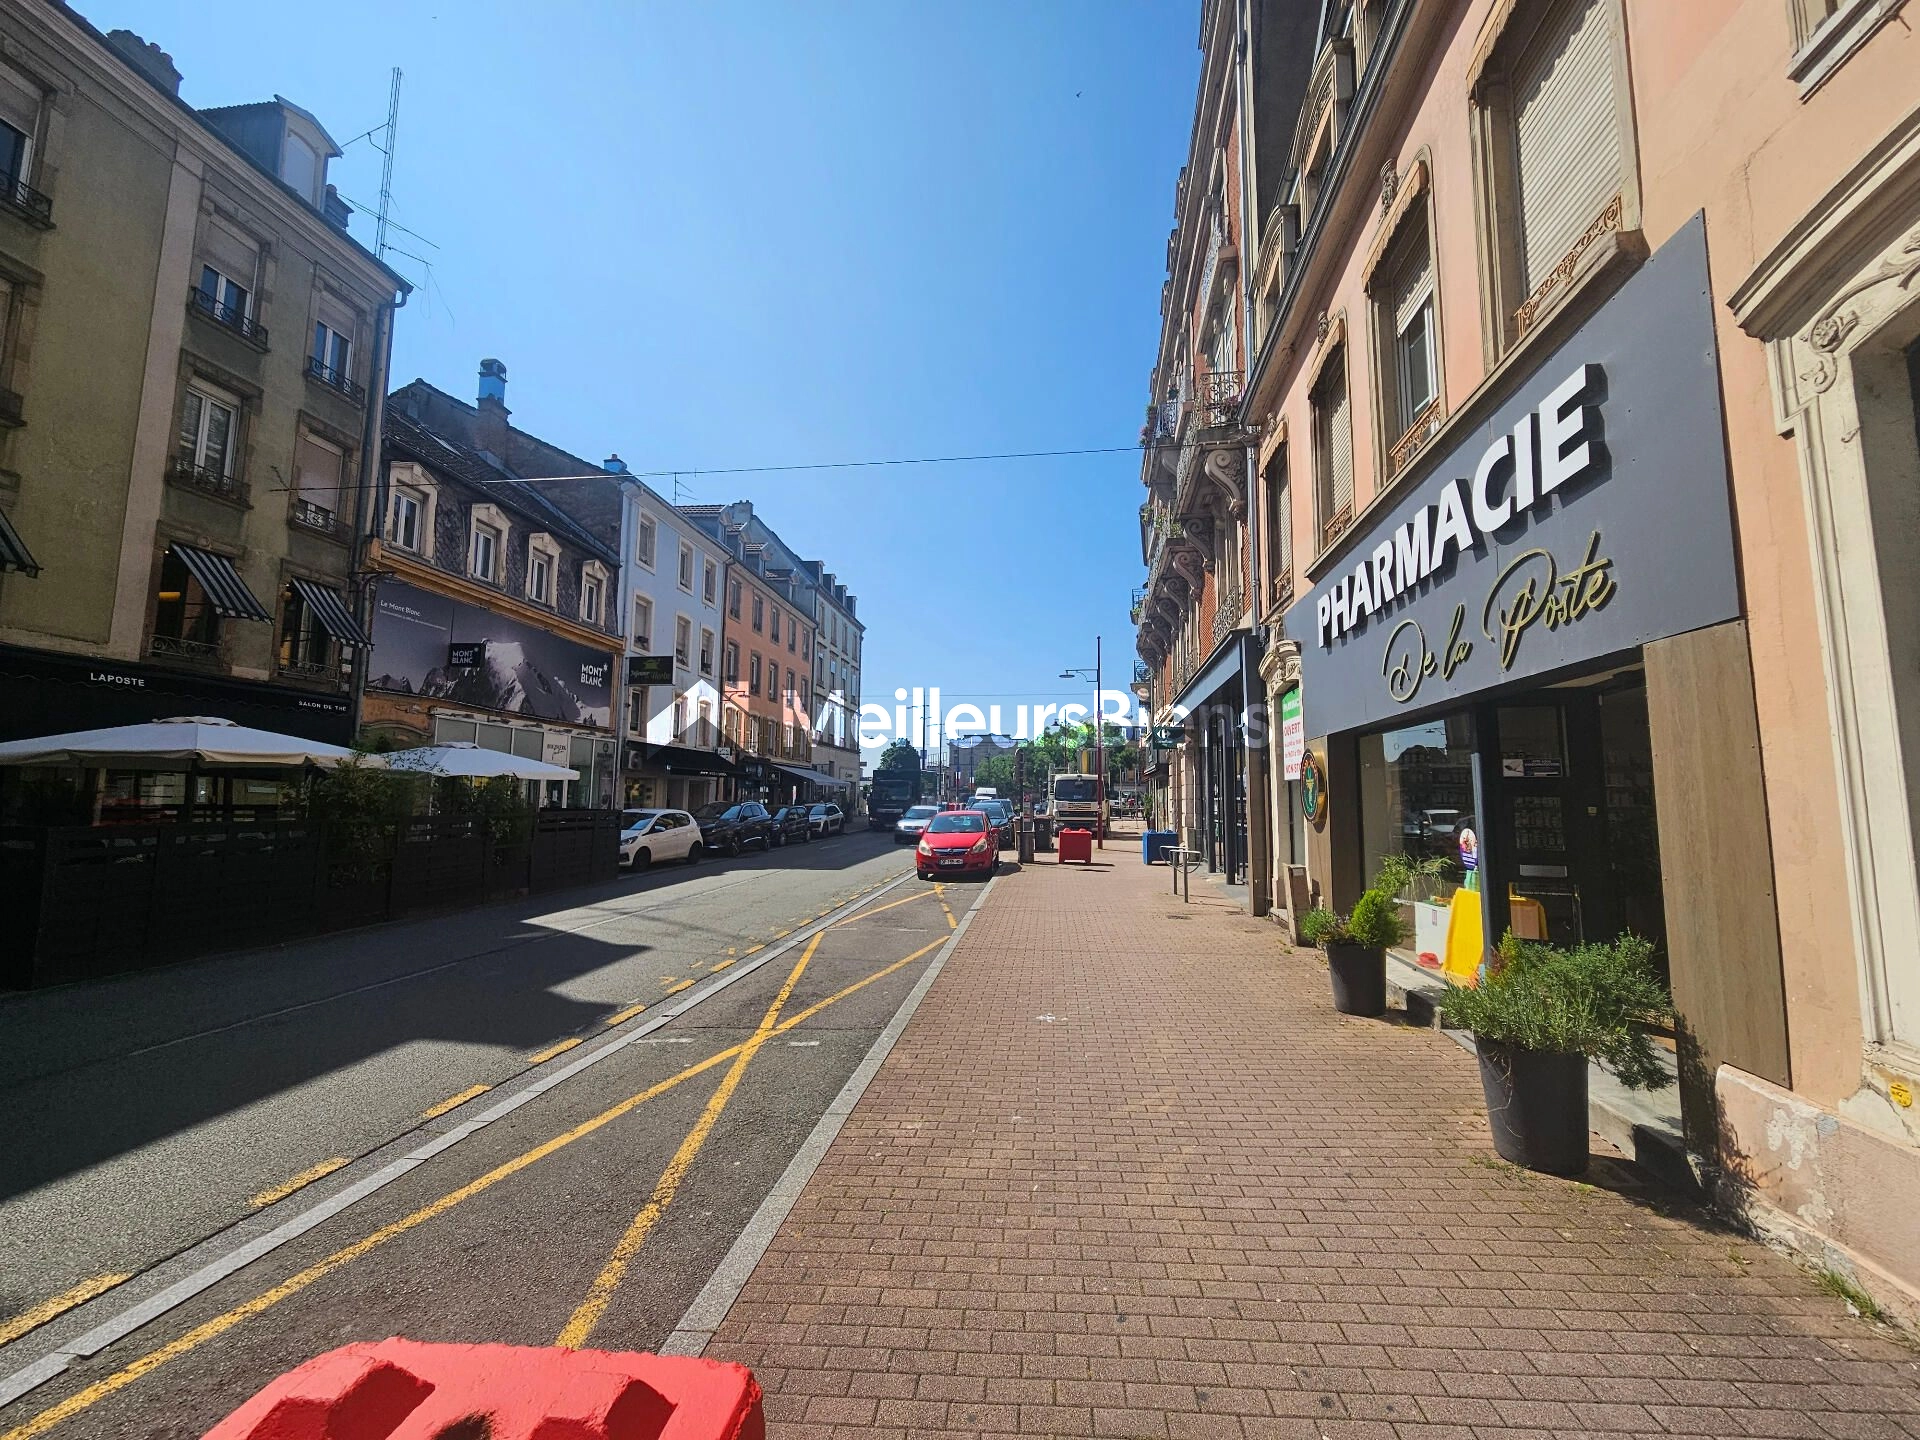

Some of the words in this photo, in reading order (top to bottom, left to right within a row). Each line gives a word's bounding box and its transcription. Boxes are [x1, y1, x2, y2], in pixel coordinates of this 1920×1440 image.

[1317, 364, 1592, 649] PHARMACIE
[1382, 618, 1438, 702] De
[1442, 603, 1473, 679] la
[1483, 531, 1614, 670] Poste
[581, 663, 603, 677] MONT
[580, 674, 602, 688] BLANC
[298, 700, 321, 708] SALON
